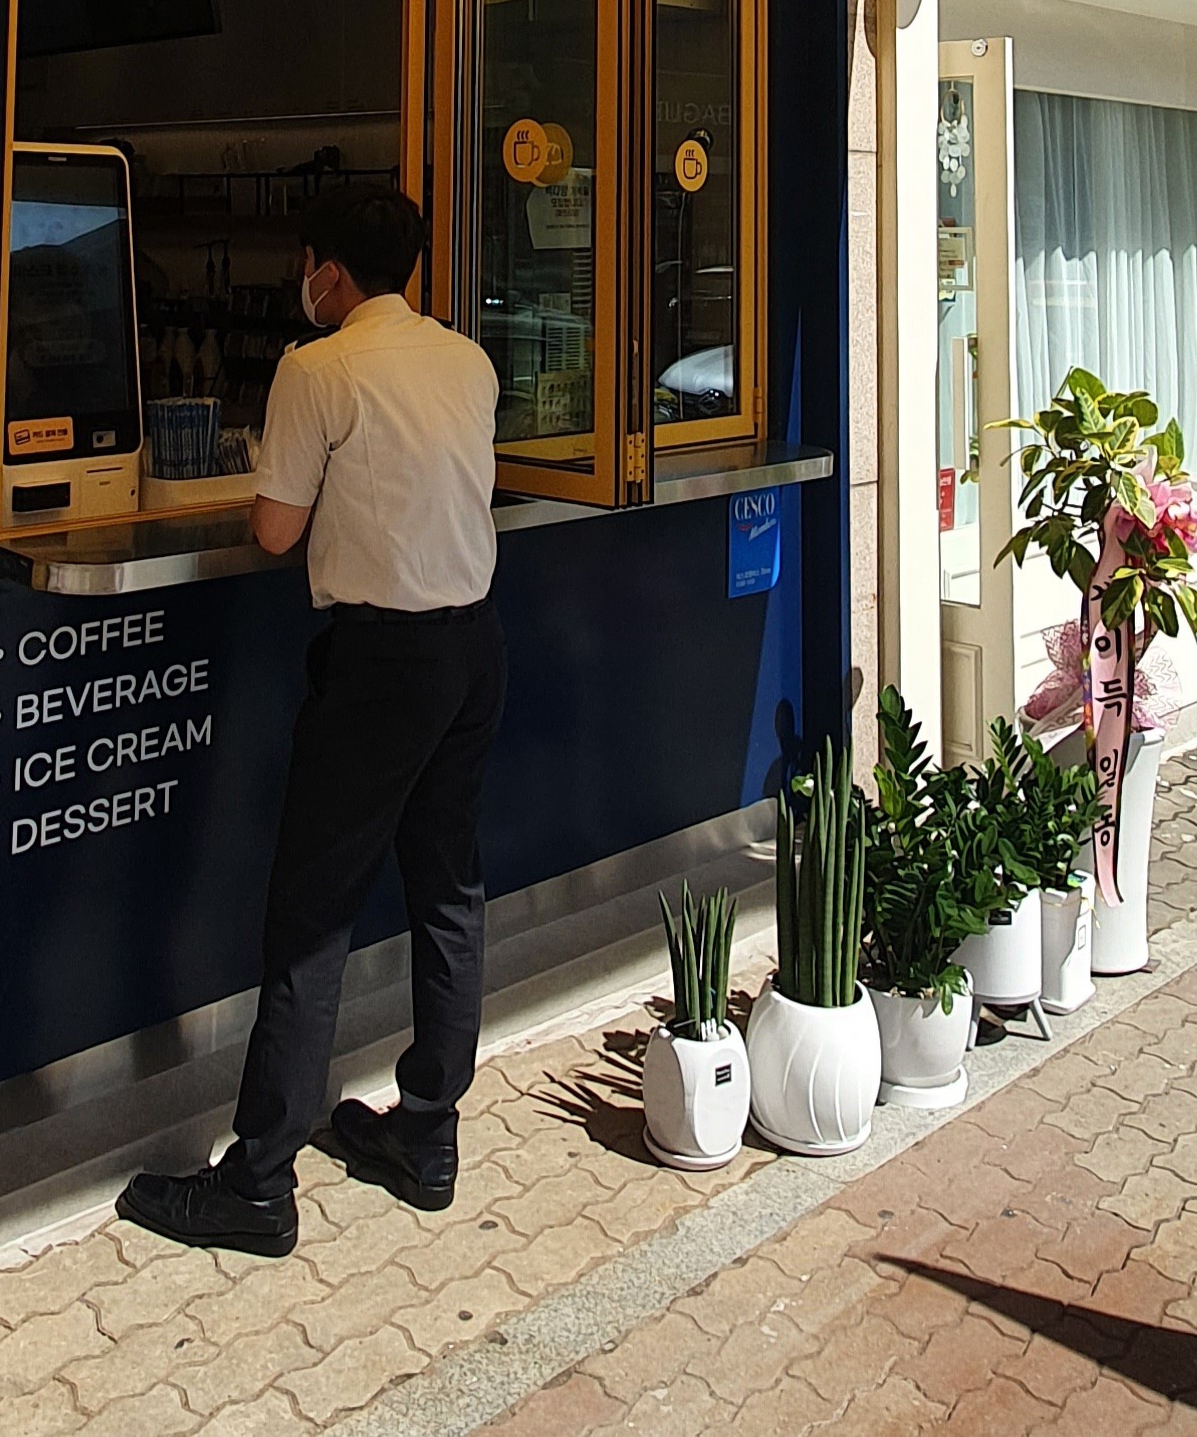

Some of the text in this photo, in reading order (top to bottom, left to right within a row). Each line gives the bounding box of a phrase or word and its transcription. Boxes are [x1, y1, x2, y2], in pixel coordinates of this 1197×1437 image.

[734, 492, 775, 521] CESCO
[18, 610, 165, 666] COFFEE
[16, 659, 209, 730] BEVERAGE
[14, 714, 212, 792] ICE CREAM
[11, 779, 179, 855] DESSERT
